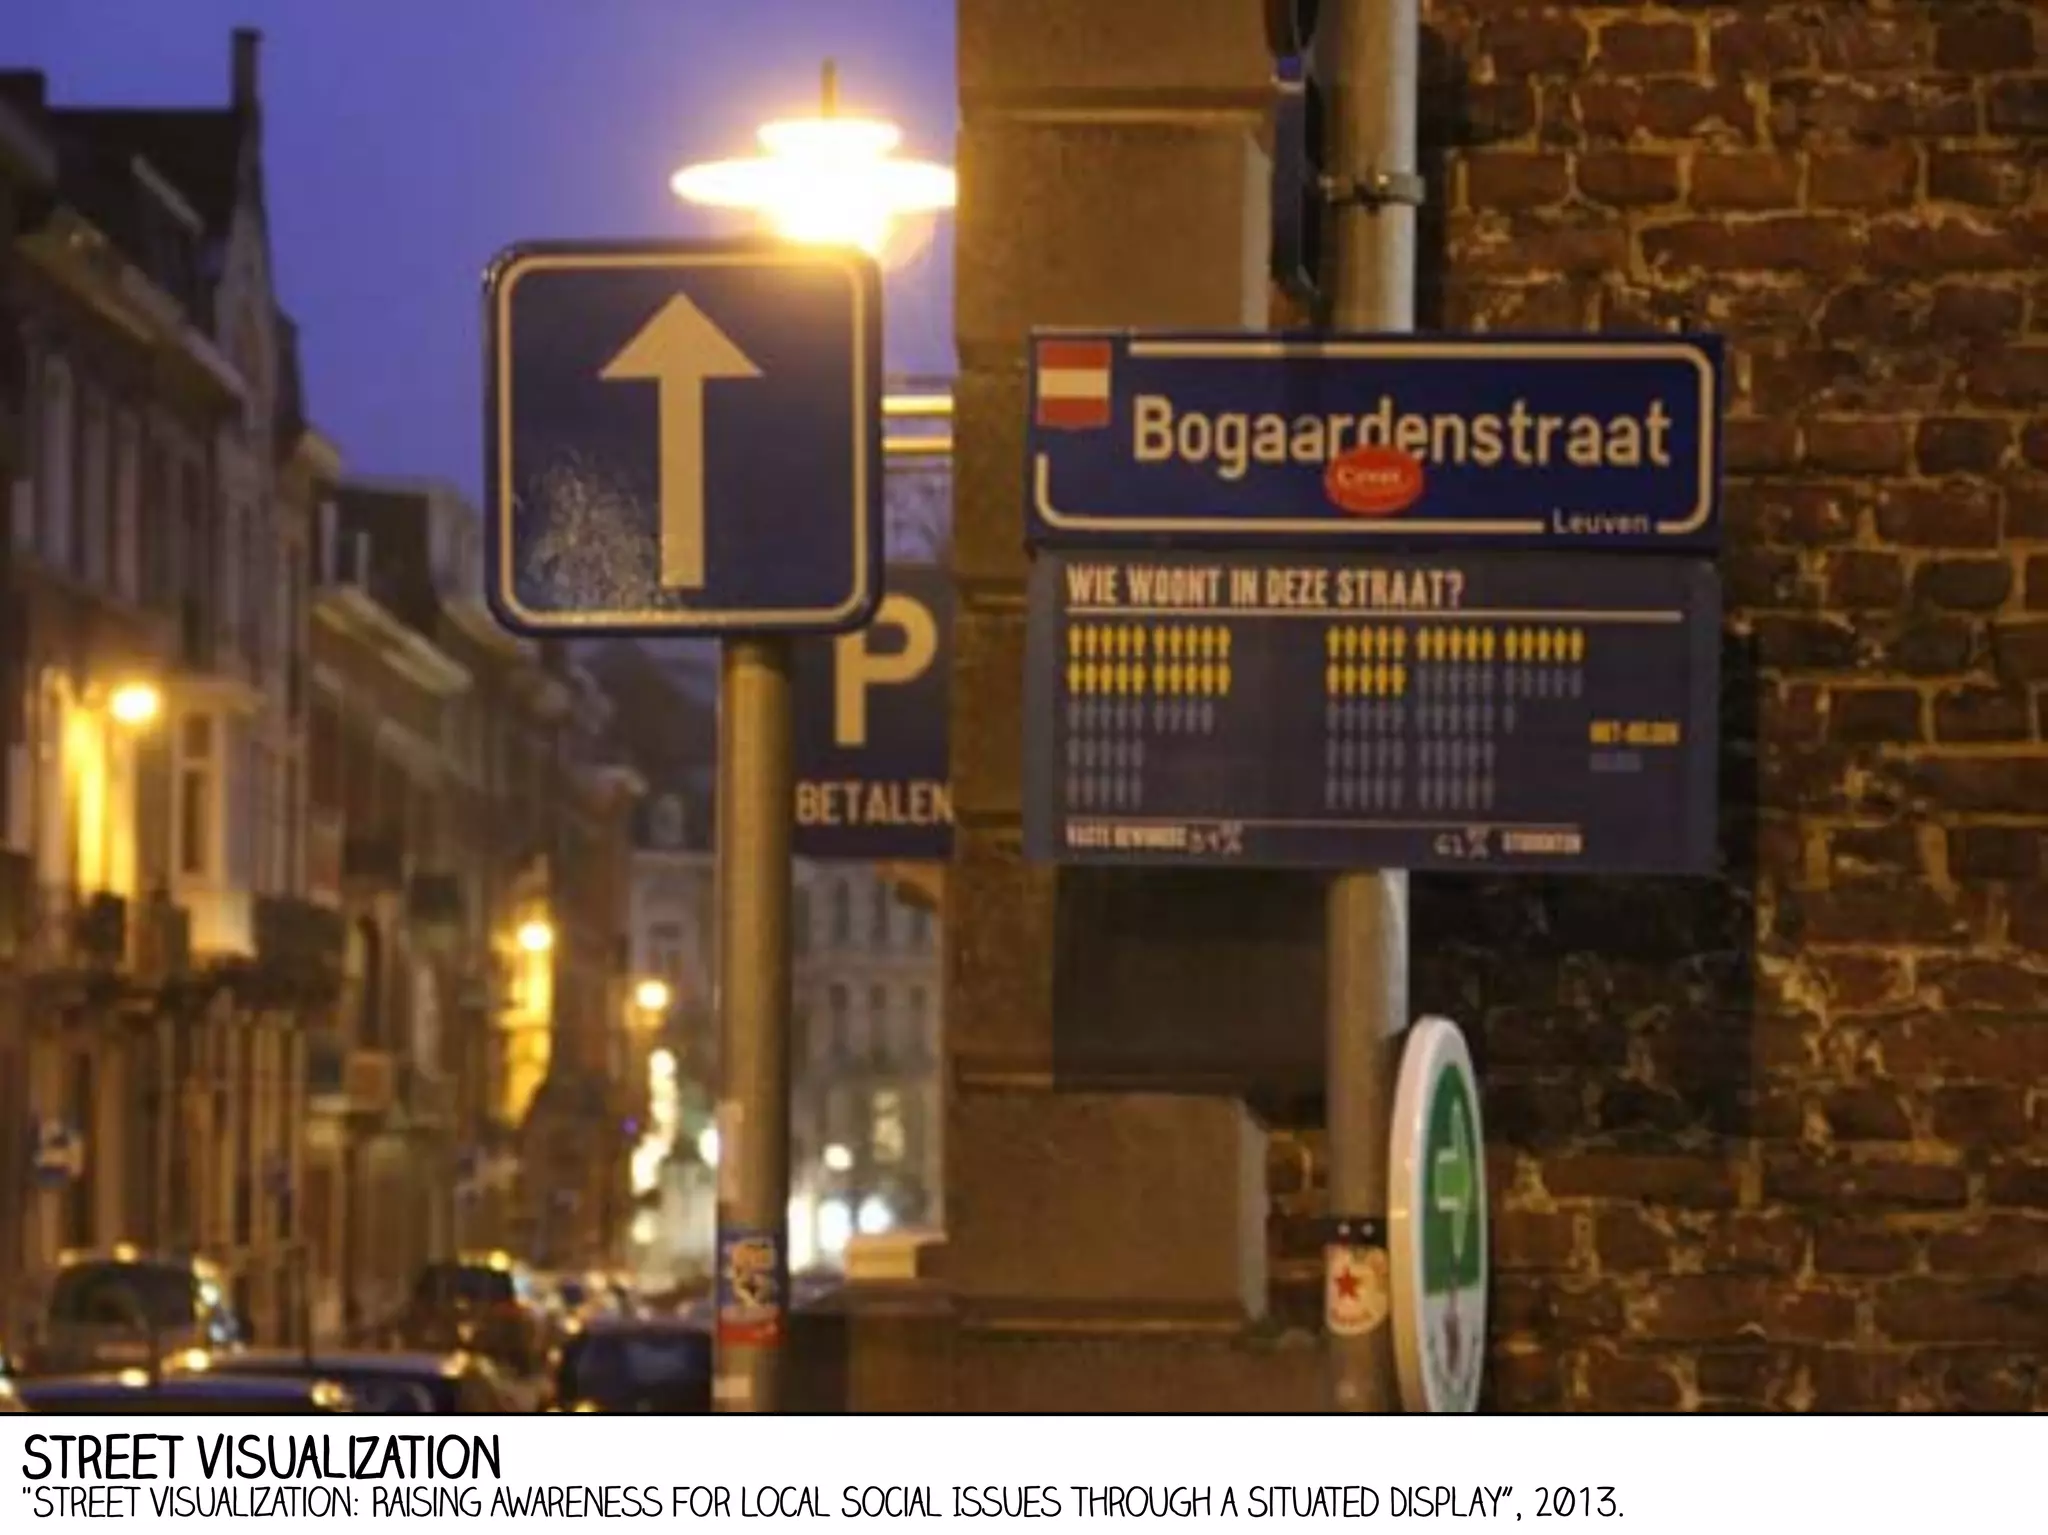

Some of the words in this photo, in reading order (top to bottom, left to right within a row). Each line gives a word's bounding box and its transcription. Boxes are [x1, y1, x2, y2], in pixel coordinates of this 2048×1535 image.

[1132, 395, 1672, 480] Bogaardenstraat
[1552, 509, 1649, 535] Leuven
[1065, 564, 1119, 605] WIE
[1126, 565, 1221, 605] WOONT
[1230, 567, 1257, 605] IN
[1264, 568, 1328, 605] DEZE
[1336, 568, 1464, 607] STRAAT?
[834, 594, 937, 746] P
[794, 781, 954, 825] BETALEN
